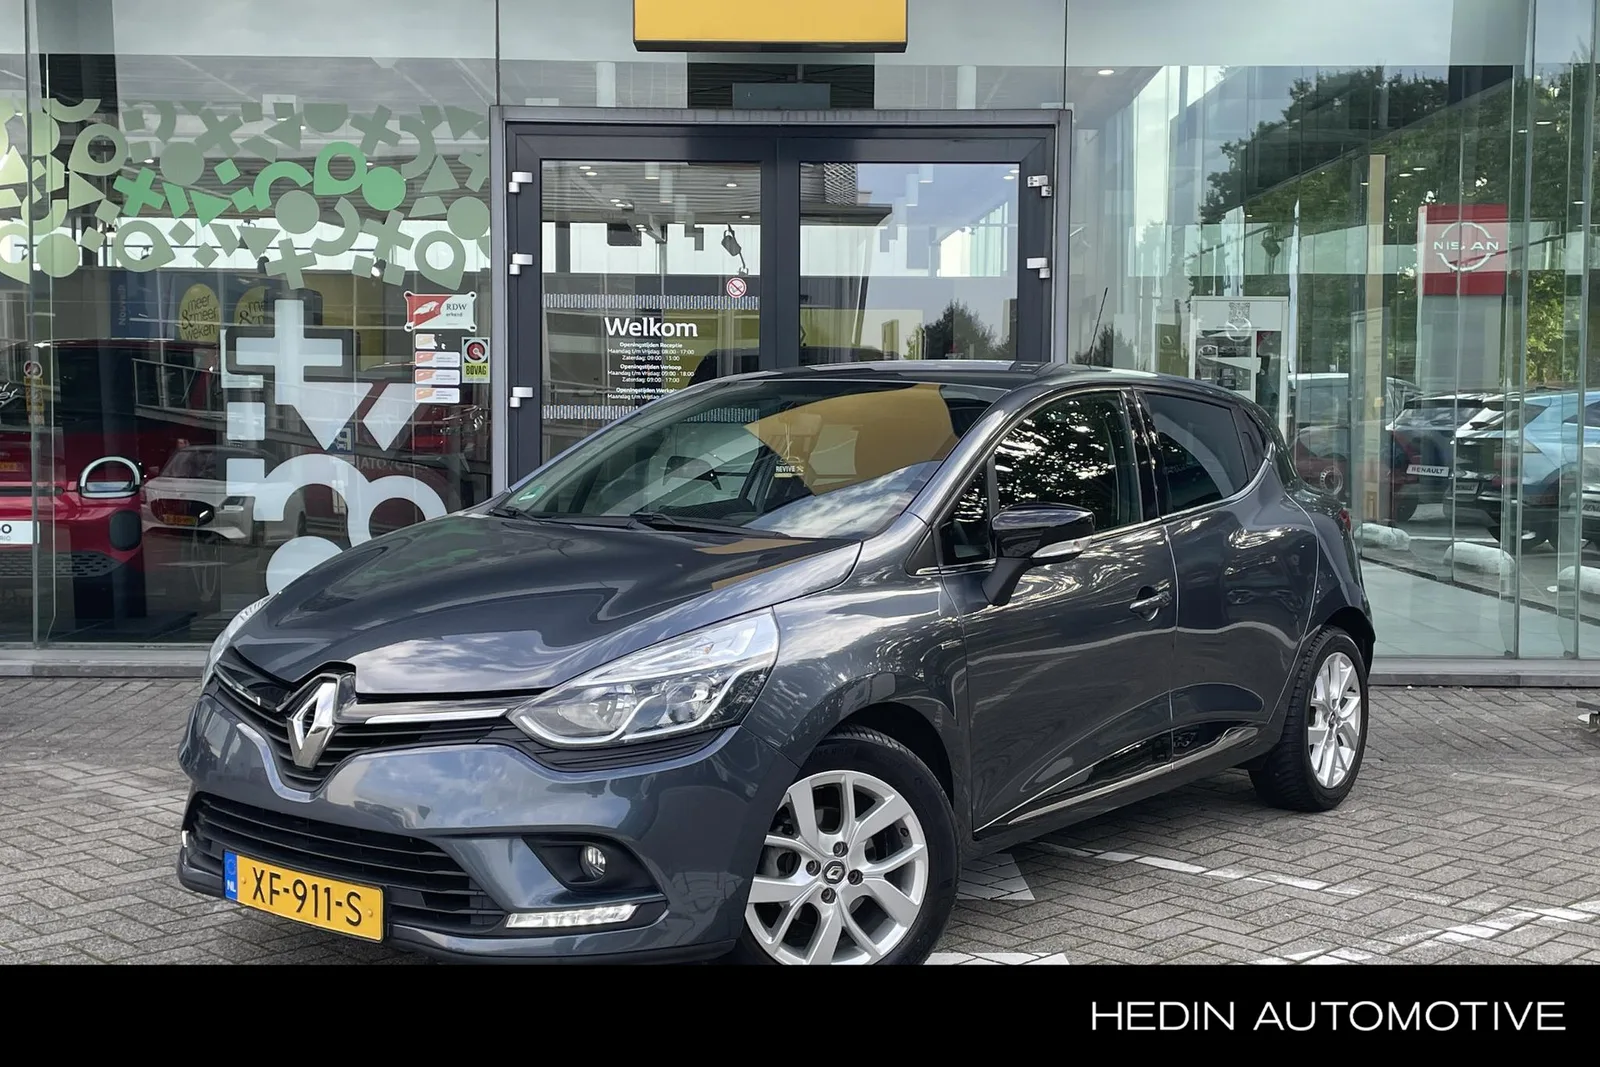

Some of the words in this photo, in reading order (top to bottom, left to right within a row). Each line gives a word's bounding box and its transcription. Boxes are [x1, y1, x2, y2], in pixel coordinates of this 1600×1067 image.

[604, 317, 698, 337] Welkom
[465, 365, 487, 375] BOVAG
[775, 465, 796, 473] REVIVE
[1411, 466, 1444, 474] RENAULT
[226, 880, 237, 893] NL
[252, 866, 362, 927] XF-911-S
